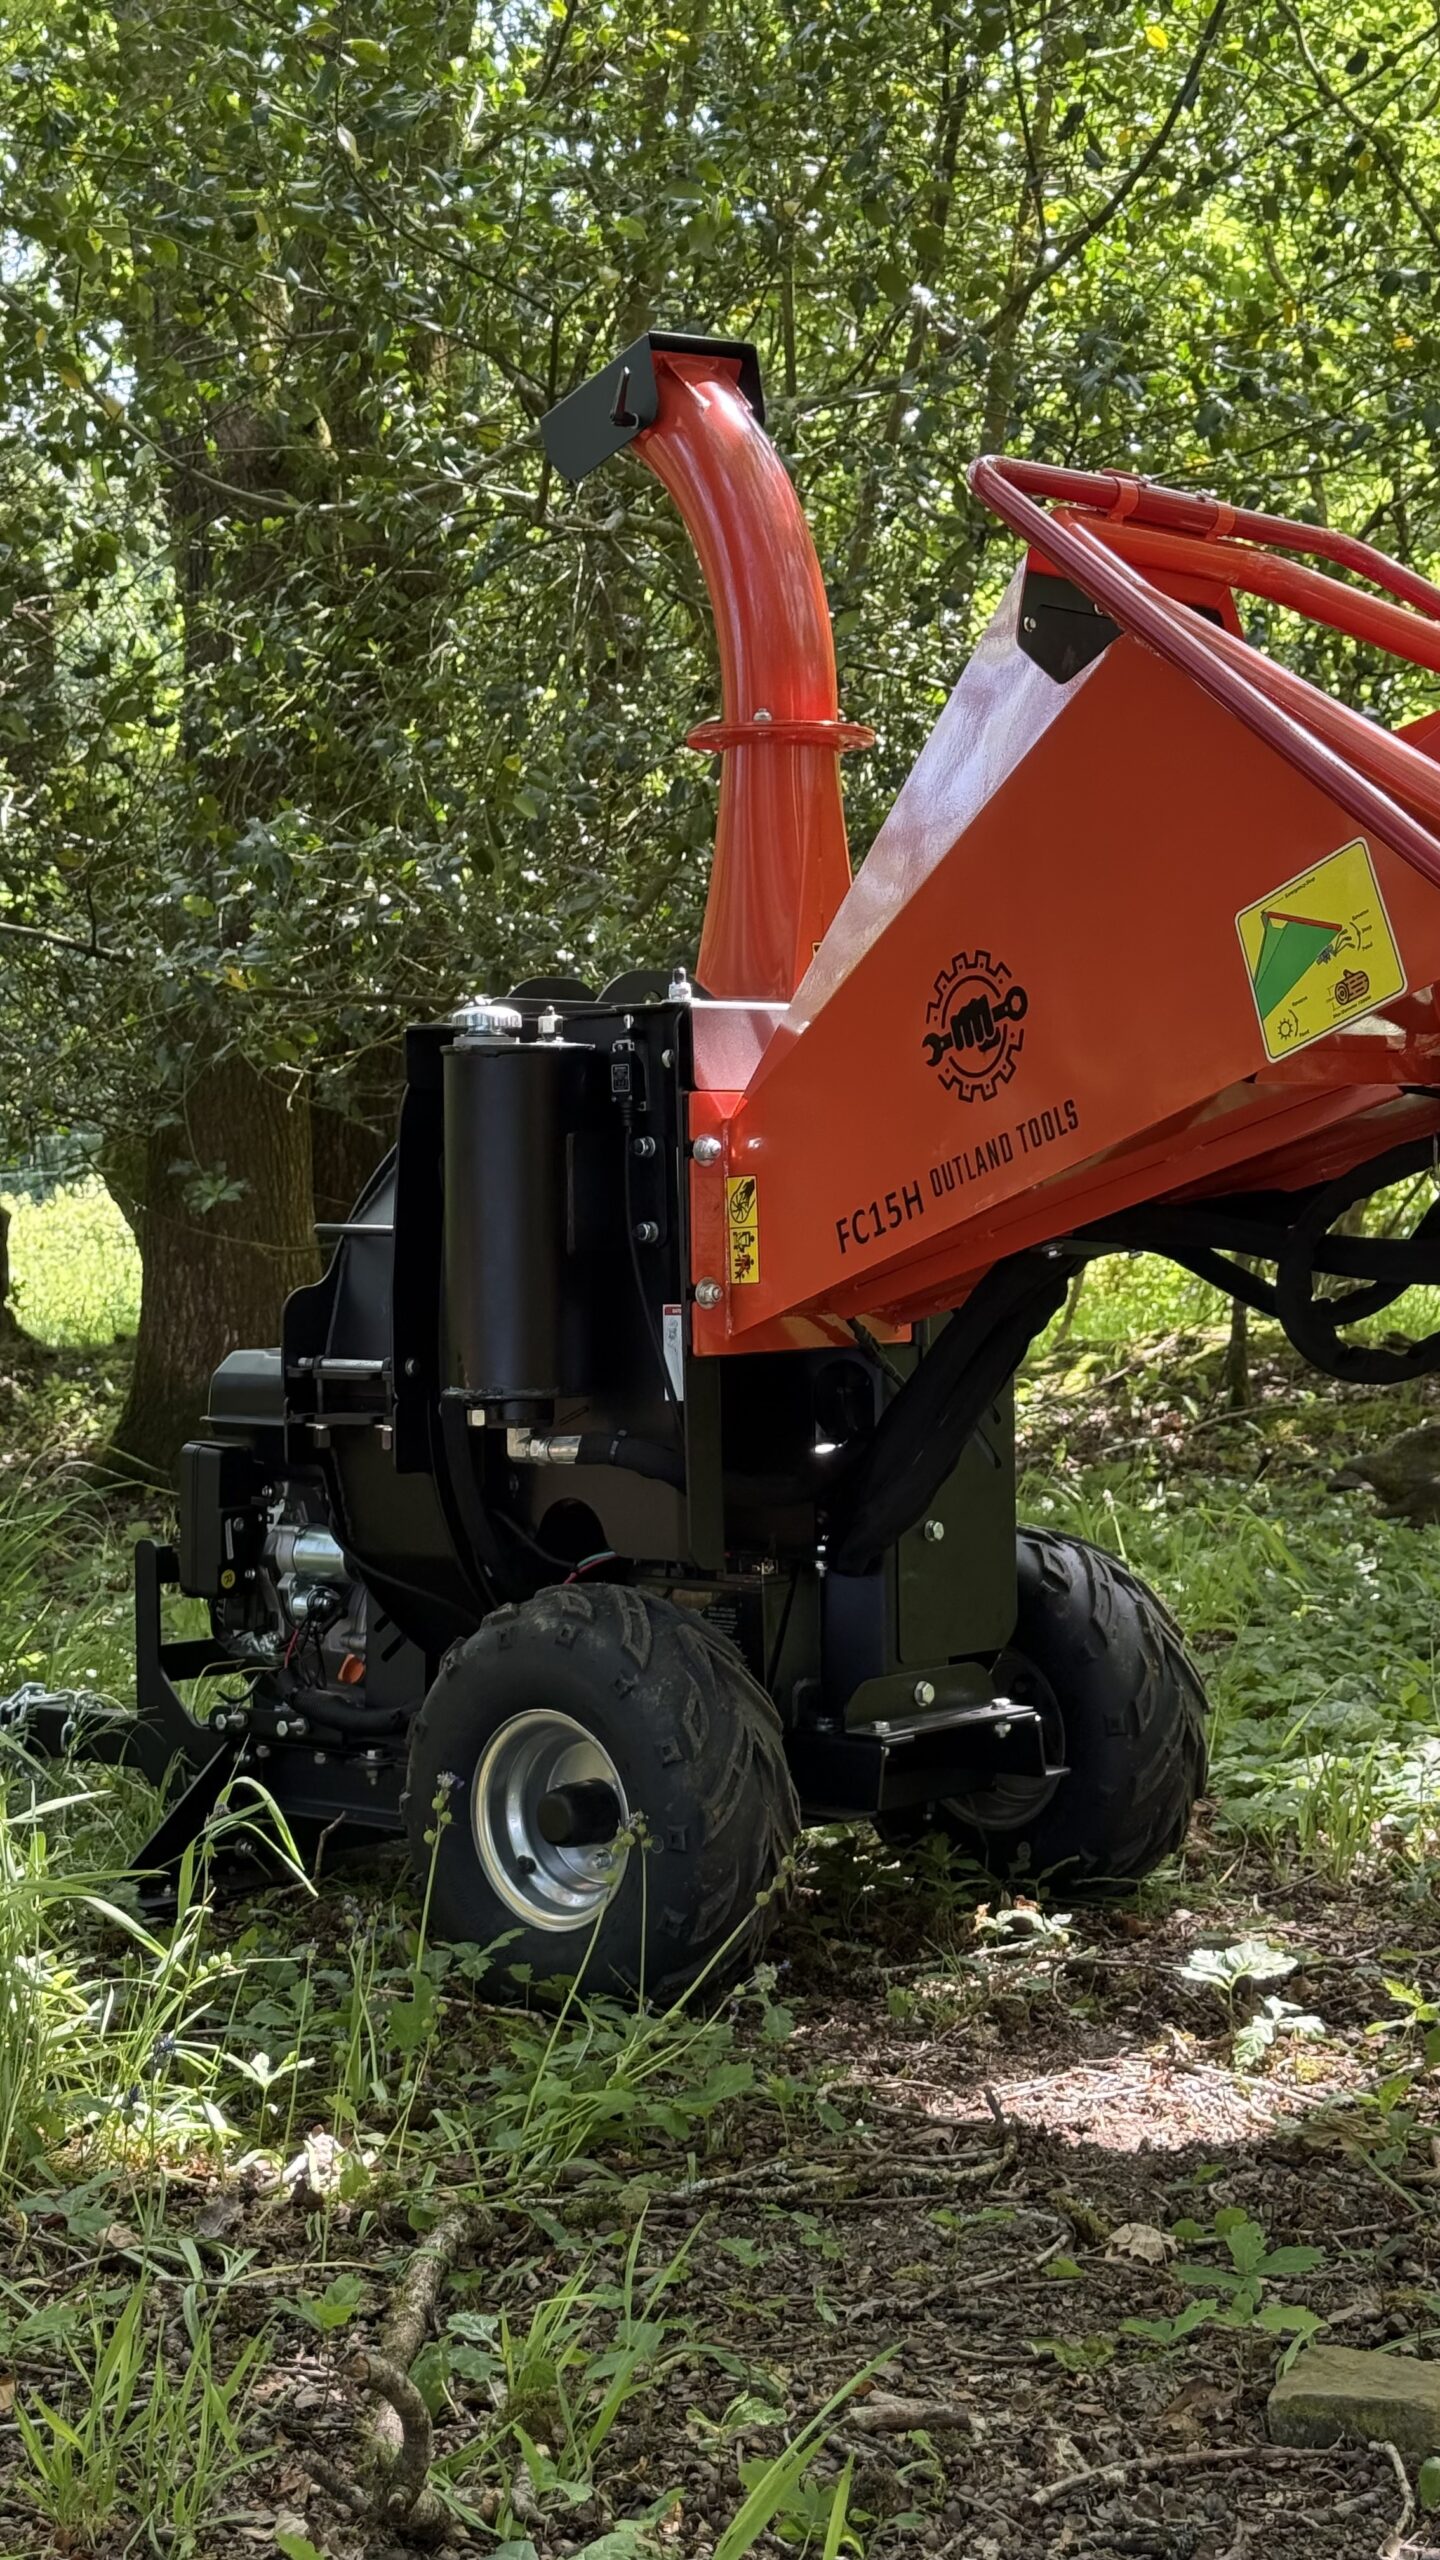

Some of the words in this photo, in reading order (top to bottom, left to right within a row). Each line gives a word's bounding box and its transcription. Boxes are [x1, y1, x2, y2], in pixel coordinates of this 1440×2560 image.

[835, 1180, 924, 1255] FC15H
[929, 1132, 1014, 1198] OUTLAND
[1016, 1099, 1079, 1153] TOOLS
